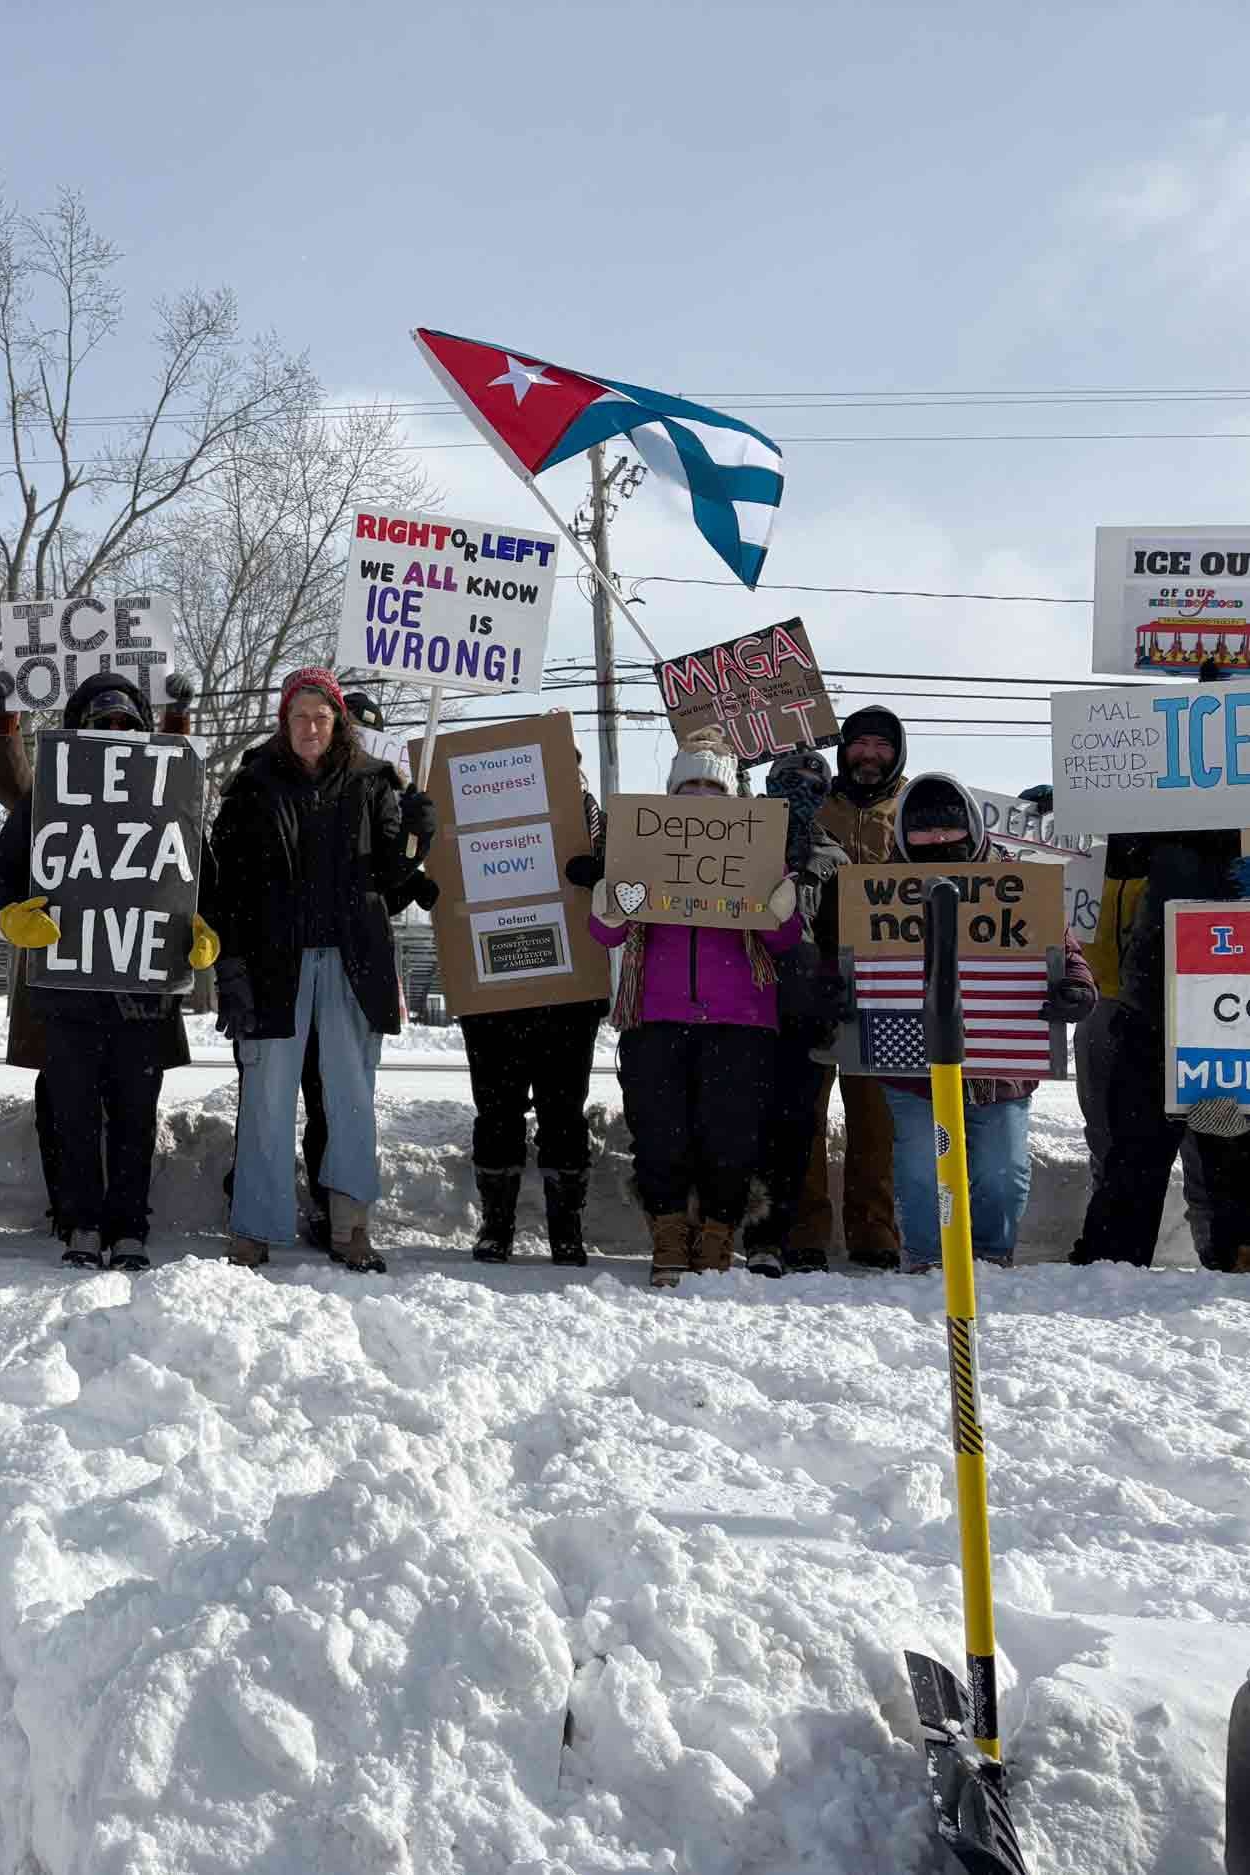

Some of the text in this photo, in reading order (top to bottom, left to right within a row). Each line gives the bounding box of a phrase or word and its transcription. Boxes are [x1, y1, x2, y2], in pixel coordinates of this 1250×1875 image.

[356, 513, 555, 567] RIGHT OR LEFT
[1134, 551, 1191, 576] ICE
[360, 559, 539, 604] WE ALL KNOW
[13, 597, 152, 657] ICE
[366, 584, 493, 635] ICE IS
[366, 626, 521, 685] WRONG!
[661, 626, 813, 709] MAGA
[15, 651, 167, 709] OUT
[712, 691, 742, 721] IS
[749, 686, 771, 710] A
[1087, 701, 1141, 723] MAL
[1071, 727, 1160, 750] COWARD
[1153, 692, 1250, 789] ICE
[56, 741, 184, 807] LET
[459, 754, 532, 774] Do Your Job
[1063, 752, 1148, 775] PREJUD
[1069, 771, 1159, 790] INJUST
[461, 773, 536, 797] Congress!
[470, 833, 543, 854] Oversight
[637, 807, 766, 849] Deport
[32, 822, 194, 890] GAZA
[483, 857, 535, 878] NOW!
[661, 853, 746, 888] ICE
[864, 876, 923, 906] we
[498, 914, 537, 927] Defend
[870, 908, 1029, 948] no ok
[46, 905, 171, 981] LIVE
[1213, 993, 1250, 1022] C
[1177, 1060, 1250, 1089] MU
